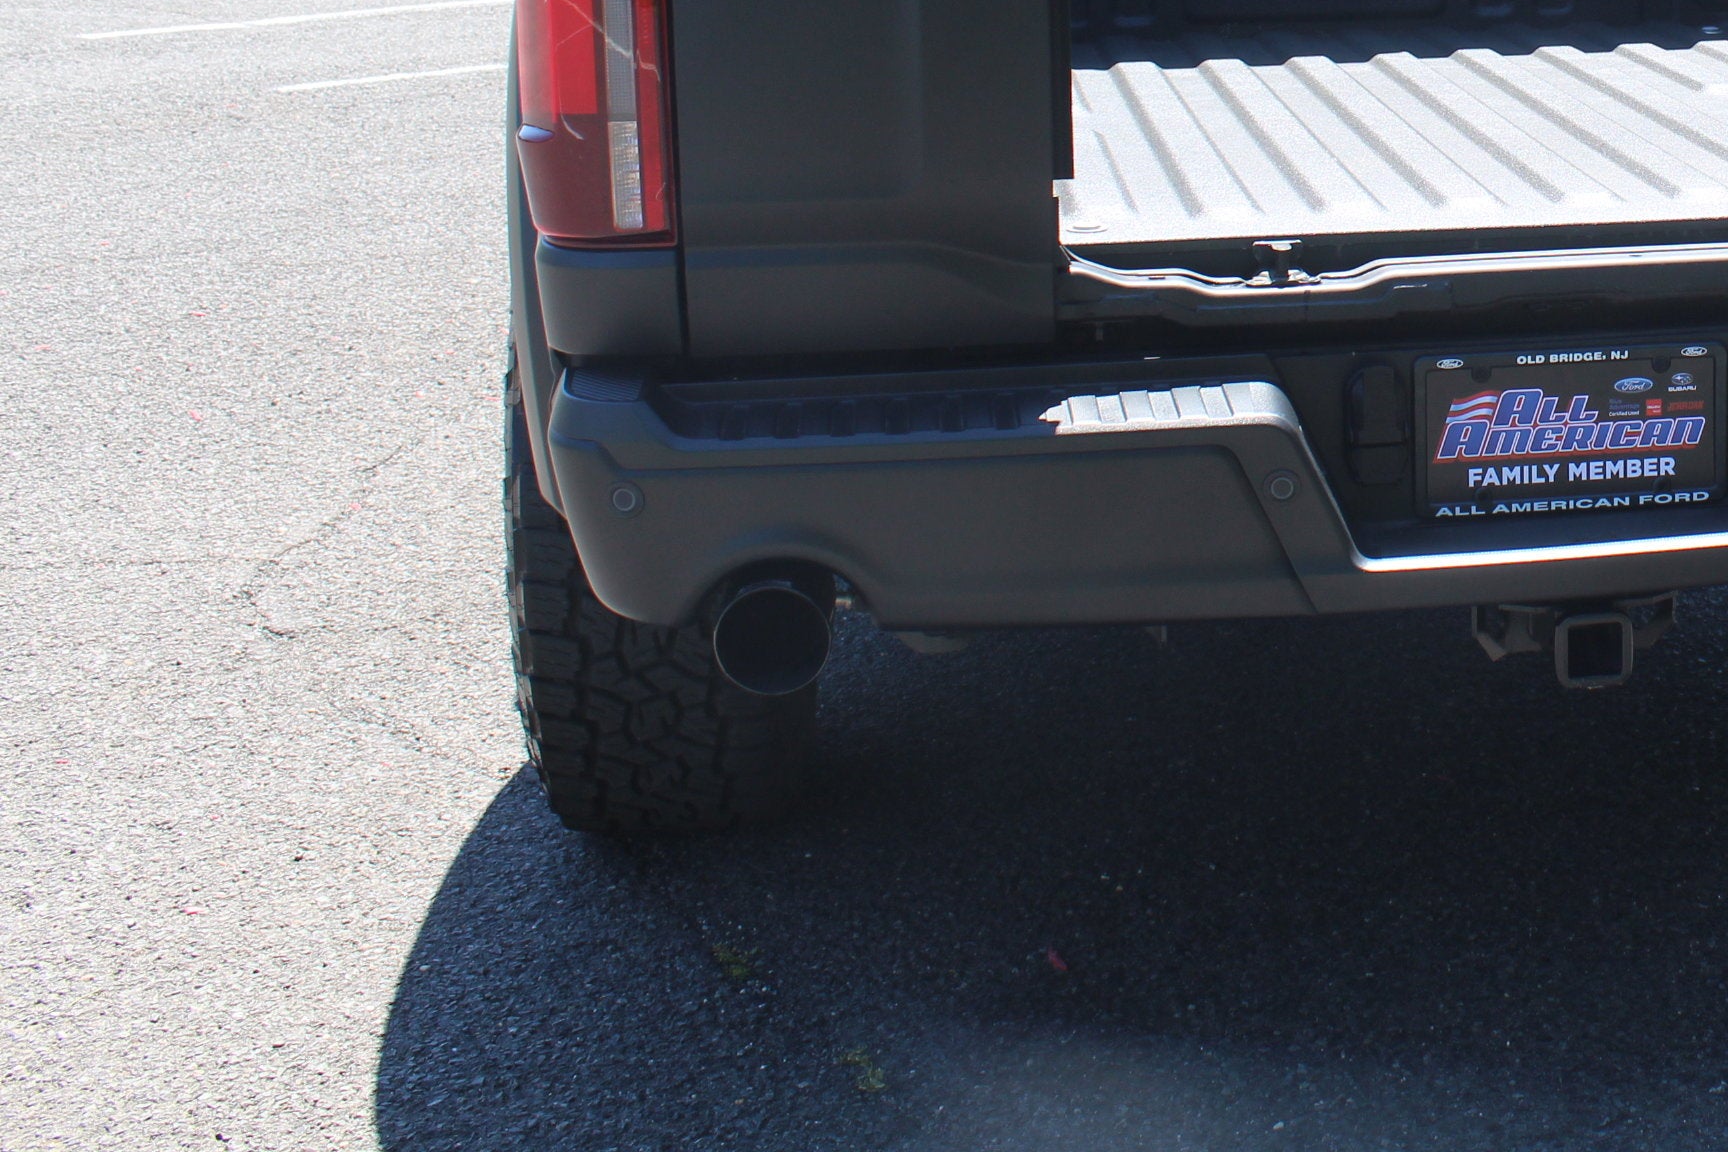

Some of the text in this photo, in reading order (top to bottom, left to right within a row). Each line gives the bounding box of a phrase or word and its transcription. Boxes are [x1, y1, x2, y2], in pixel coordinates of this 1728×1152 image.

[1516, 354, 1546, 365] OLD
[1610, 350, 1629, 360] NJ
[1620, 380, 1647, 391] Ford
[1668, 385, 1697, 393] SUBARU
[1468, 456, 1676, 488] FAMILY MEMBER
[1435, 491, 1710, 518] ALL AMERICAN FORD
